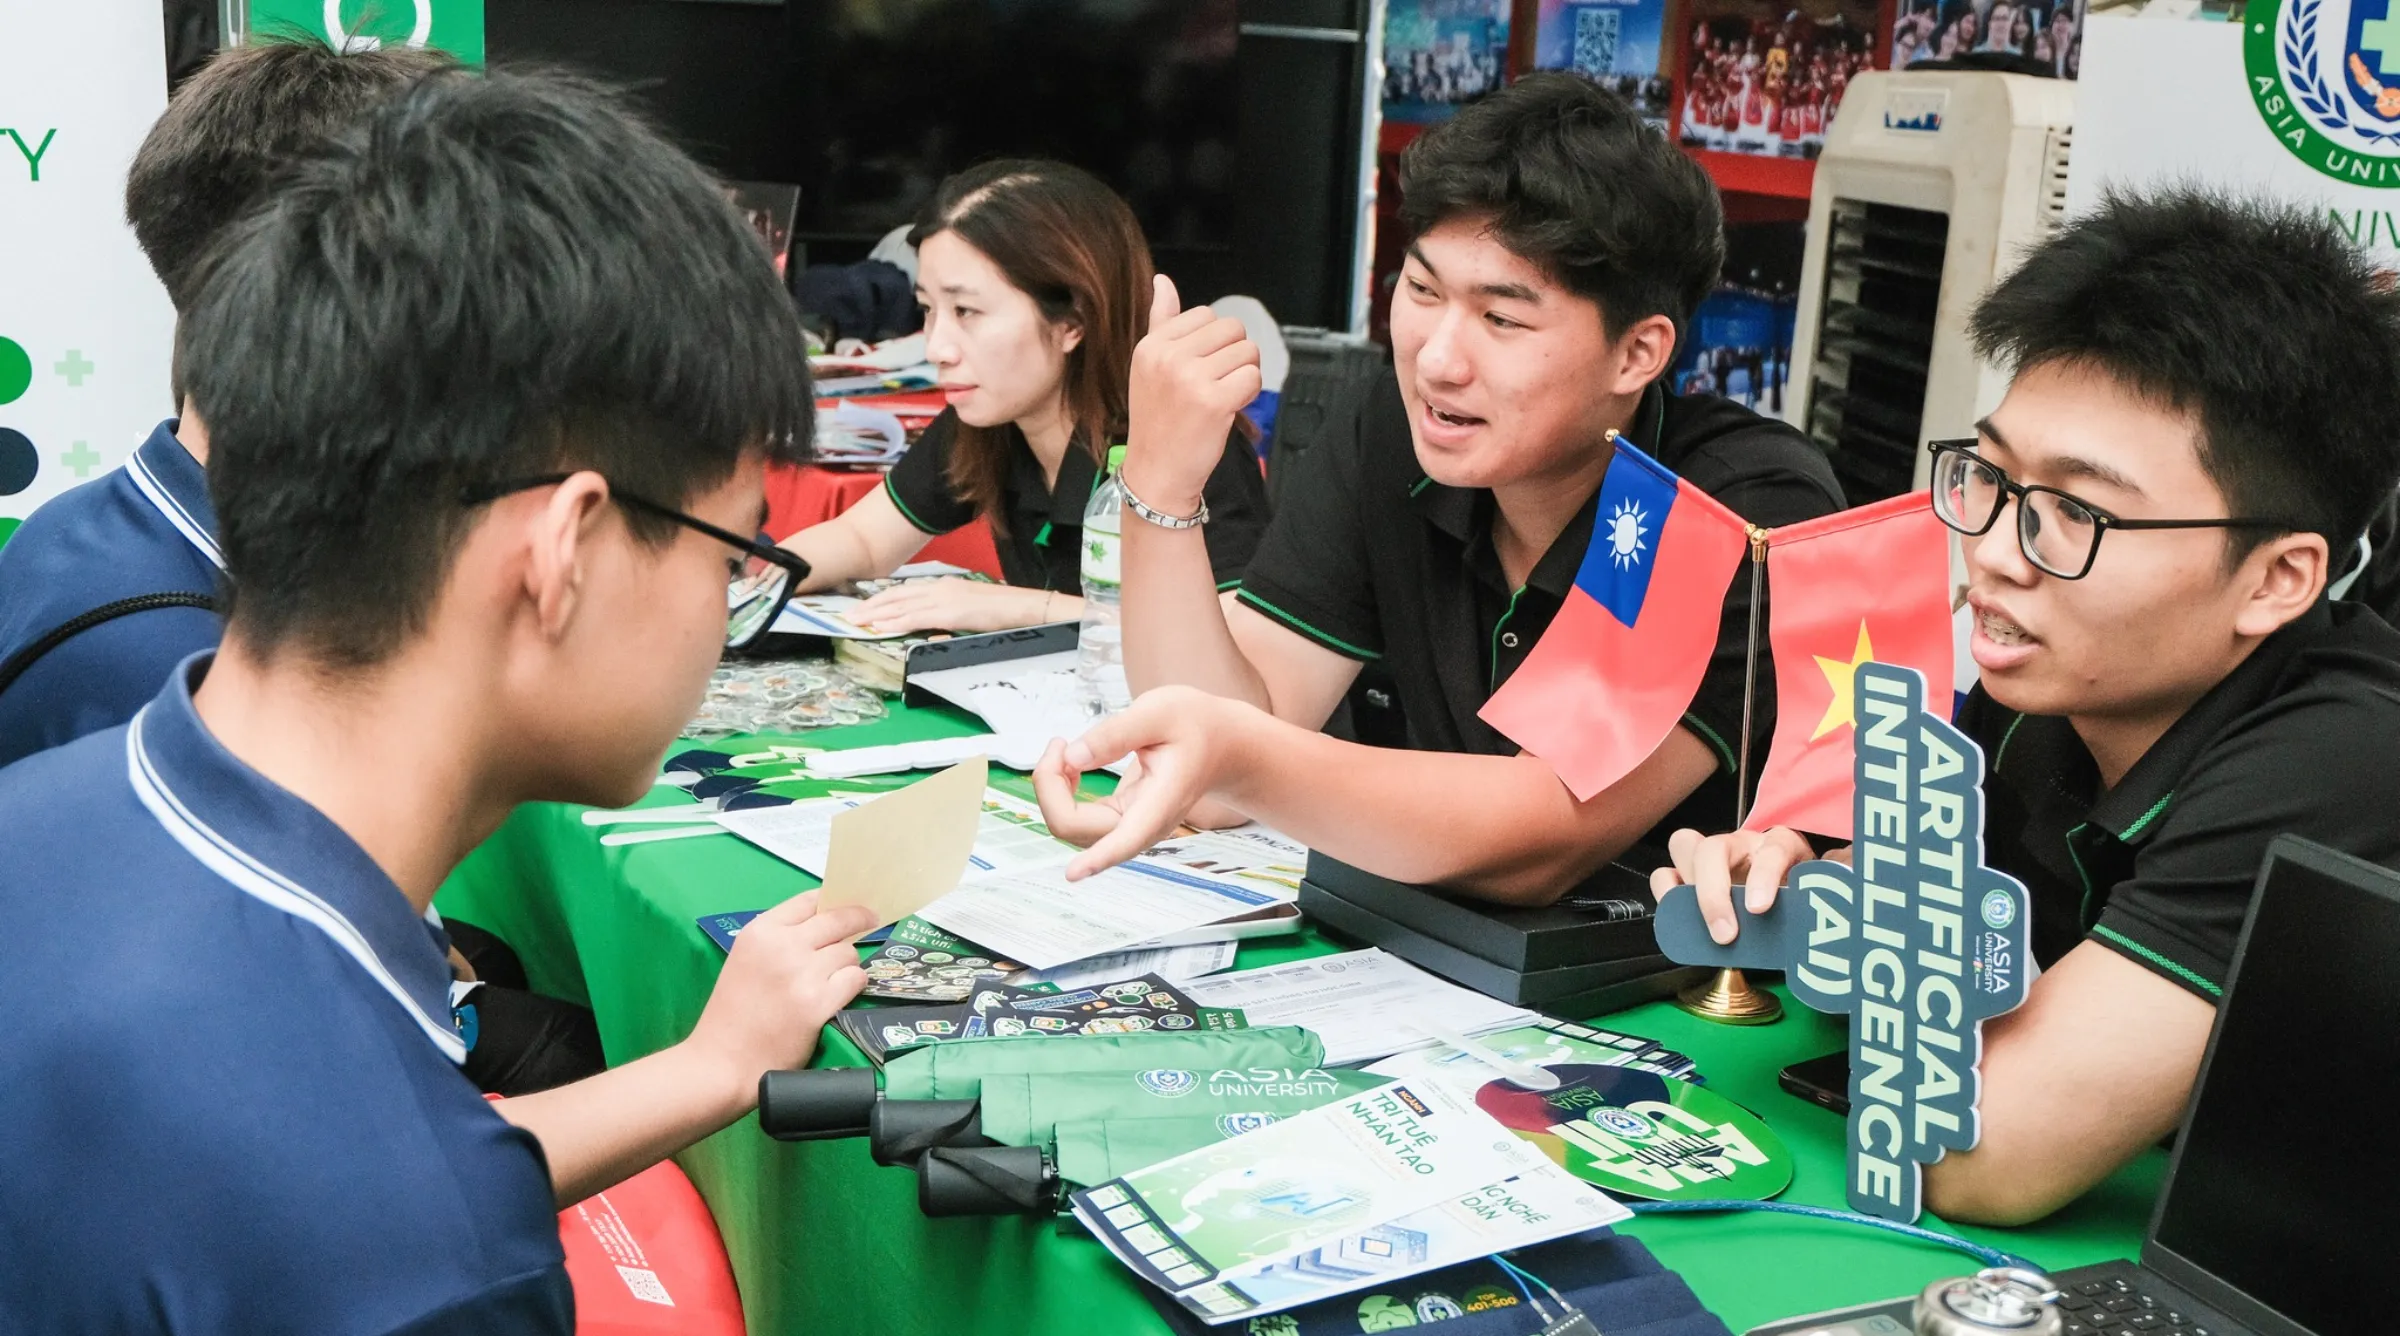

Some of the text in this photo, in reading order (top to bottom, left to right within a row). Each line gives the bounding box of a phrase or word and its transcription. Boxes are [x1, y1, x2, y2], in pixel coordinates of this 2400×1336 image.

[2255, 75, 2307, 149] ASIA
[1797, 873, 1854, 996] (AI)
[1857, 675, 1908, 1207] INTELLIGENCE
[1915, 726, 1965, 1145] ARTIFICIAL
[1985, 931, 1993, 994] UNIVERSITY
[1993, 932, 2012, 994] ASIA
[1209, 1067, 1338, 1082] ASIA
[1209, 1082, 1341, 1097] UNIVERSITY
[1550, 1090, 1605, 1111] ASIA
[1346, 1101, 1401, 1146] NHÂN
[1395, 1144, 1435, 1175] TẠO
[1372, 1091, 1403, 1118] TRÍ
[1398, 1115, 1439, 1148] TUỆ
[1497, 1195, 1552, 1225] NGHỆ
[1467, 1296, 1519, 1312] 401-500
[1476, 1293, 1496, 1302] TOP
